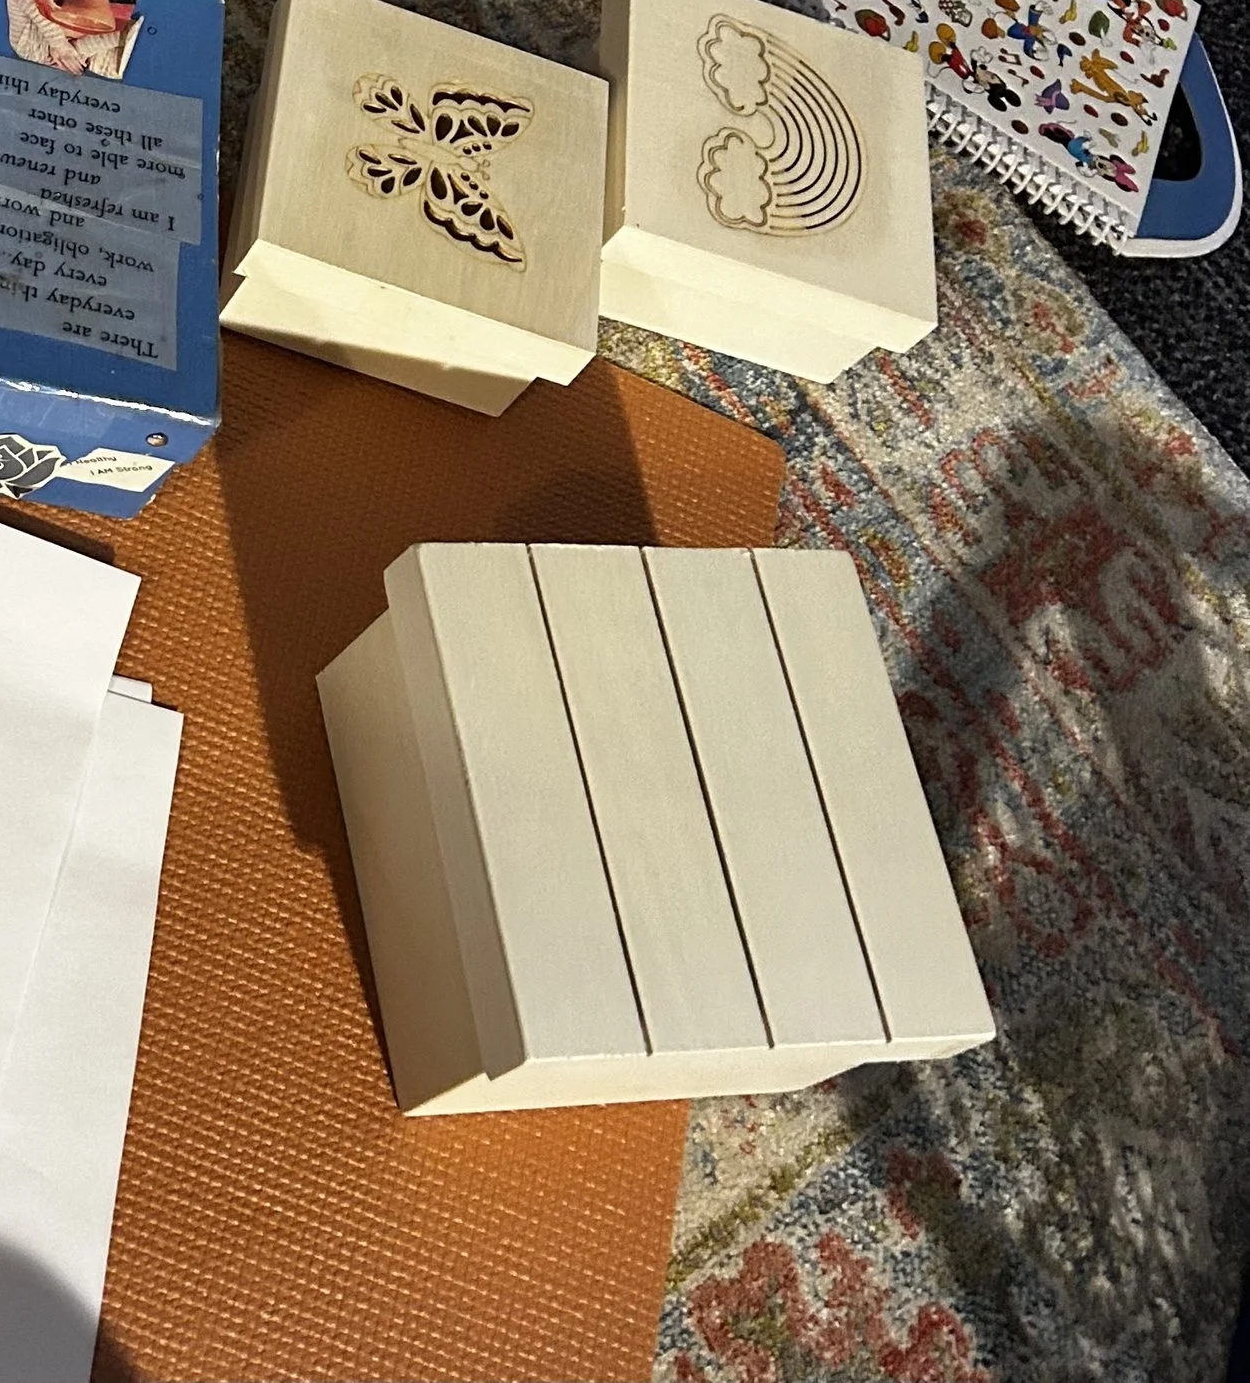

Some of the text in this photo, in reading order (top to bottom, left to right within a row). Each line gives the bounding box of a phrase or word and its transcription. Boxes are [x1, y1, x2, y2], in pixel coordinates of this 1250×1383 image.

[37, 81, 121, 113] everyday
[28, 107, 163, 151] all these other
[20, 131, 186, 180] more able to face
[64, 168, 101, 186] and
[49, 209, 85, 228] and
[131, 208, 160, 223] am
[167, 215, 175, 232] I
[98, 246, 155, 273] work,
[54, 262, 108, 287] every
[46, 287, 135, 321] everyday
[62, 321, 159, 359] There are
[75, 456, 117, 466] Healthy
[116, 465, 153, 474] Strong
